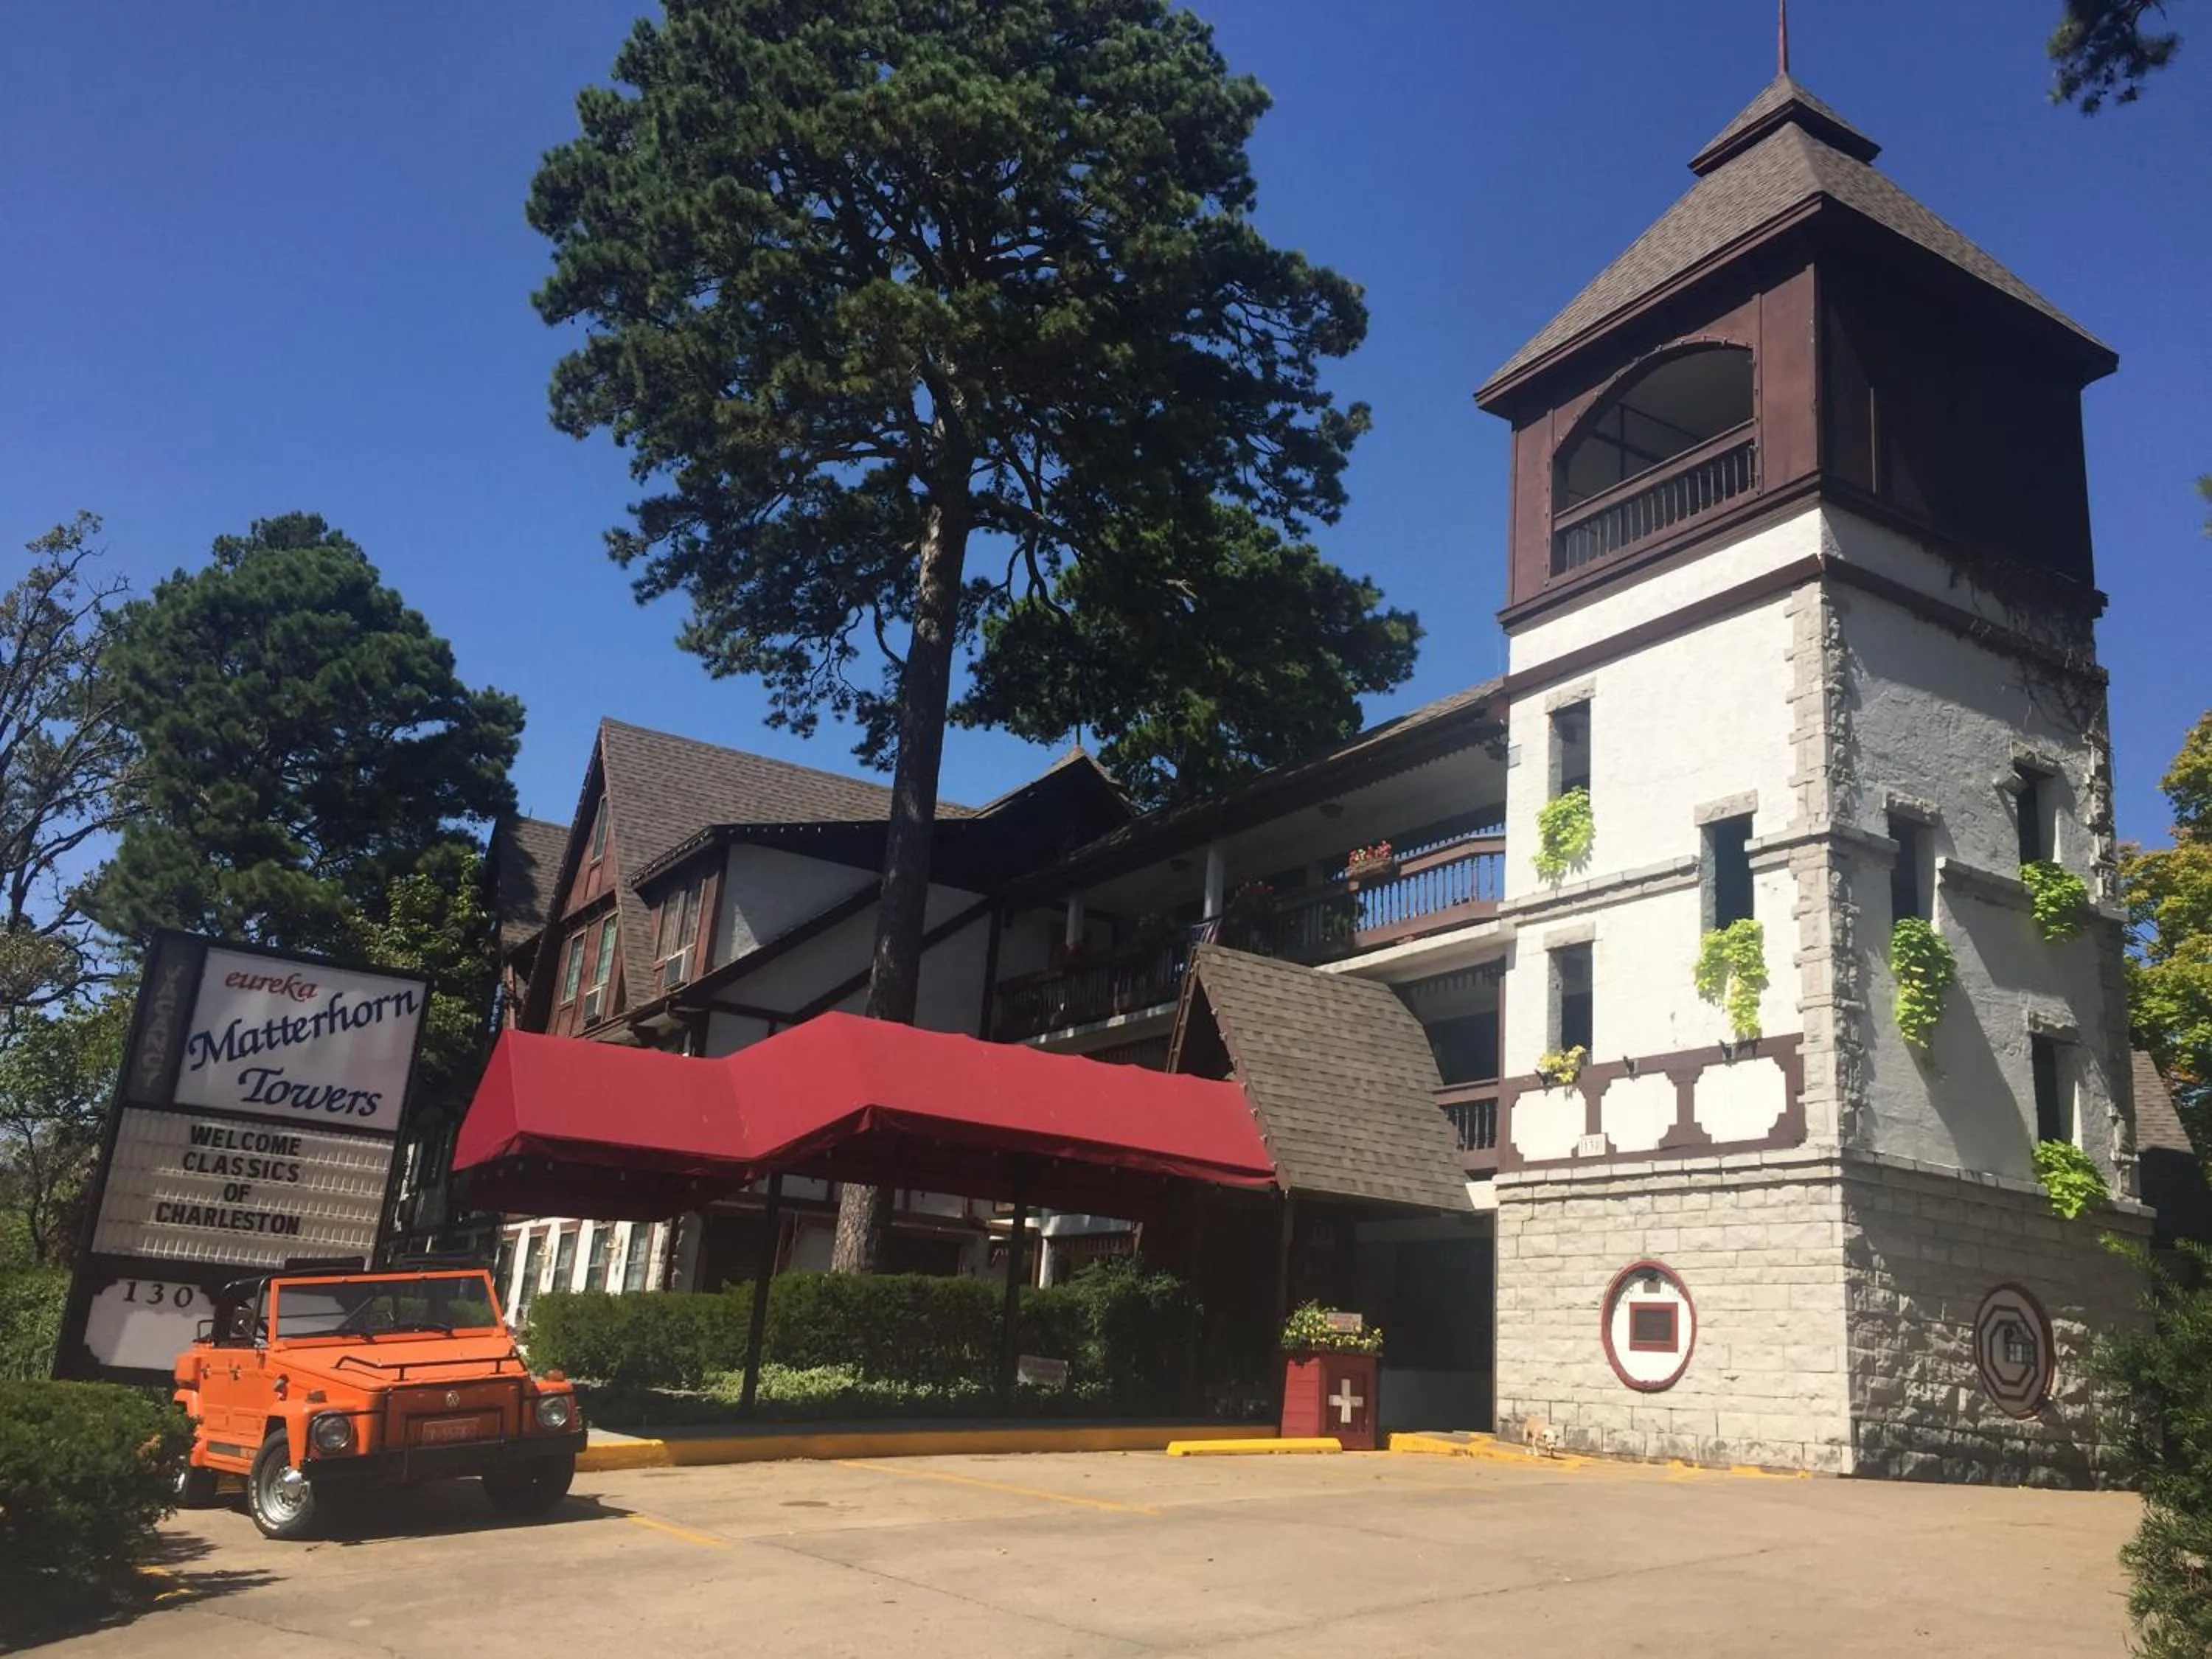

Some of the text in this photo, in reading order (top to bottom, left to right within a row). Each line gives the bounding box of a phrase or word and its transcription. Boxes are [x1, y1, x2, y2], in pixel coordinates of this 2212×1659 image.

[225, 971, 318, 1002] eureka
[188, 990, 418, 1071] Matterhorn
[237, 1068, 383, 1116] Towers
[190, 1125, 302, 1156] WELCOME
[183, 1152, 300, 1182] CLASSICS
[223, 1183, 251, 1203] OF
[156, 1202, 302, 1235] CHARLESTON
[123, 1281, 193, 1308] 130
